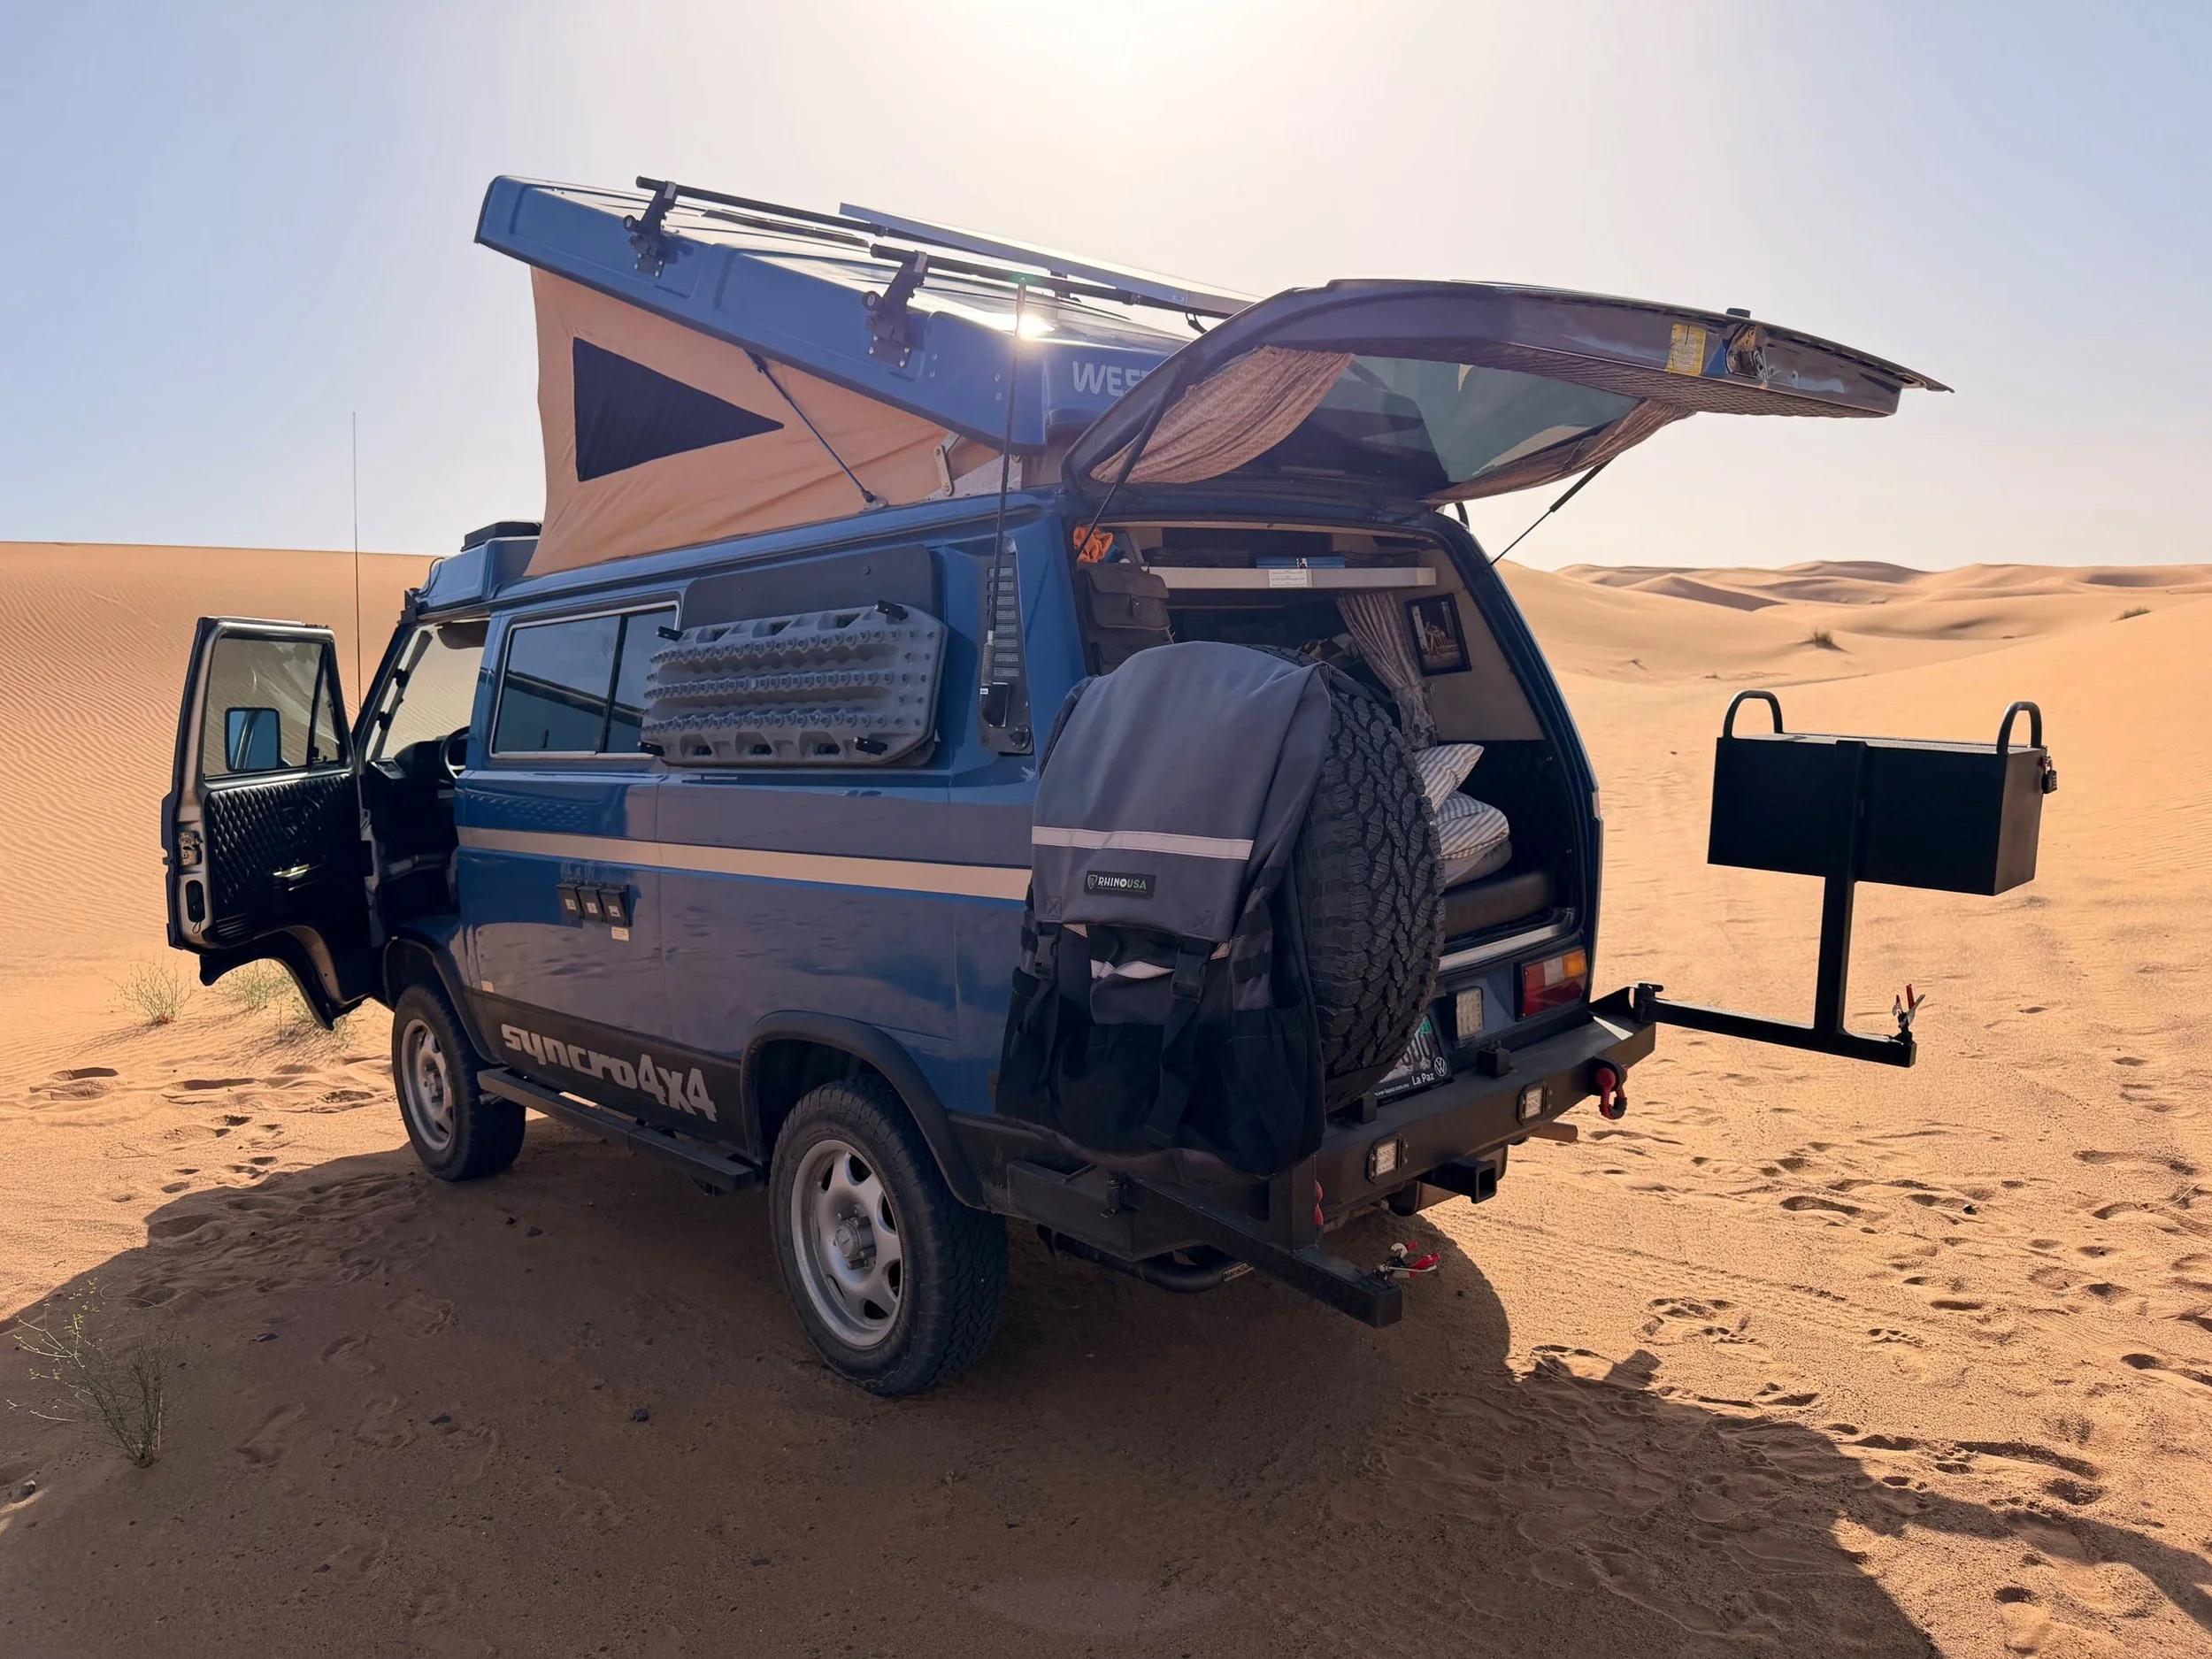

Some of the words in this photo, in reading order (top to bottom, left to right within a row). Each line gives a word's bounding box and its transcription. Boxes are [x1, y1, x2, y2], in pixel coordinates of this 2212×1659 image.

[1072, 361, 1149, 397] WES
[1411, 1076, 1421, 1086] La
[1421, 1072, 1434, 1083] Paz
